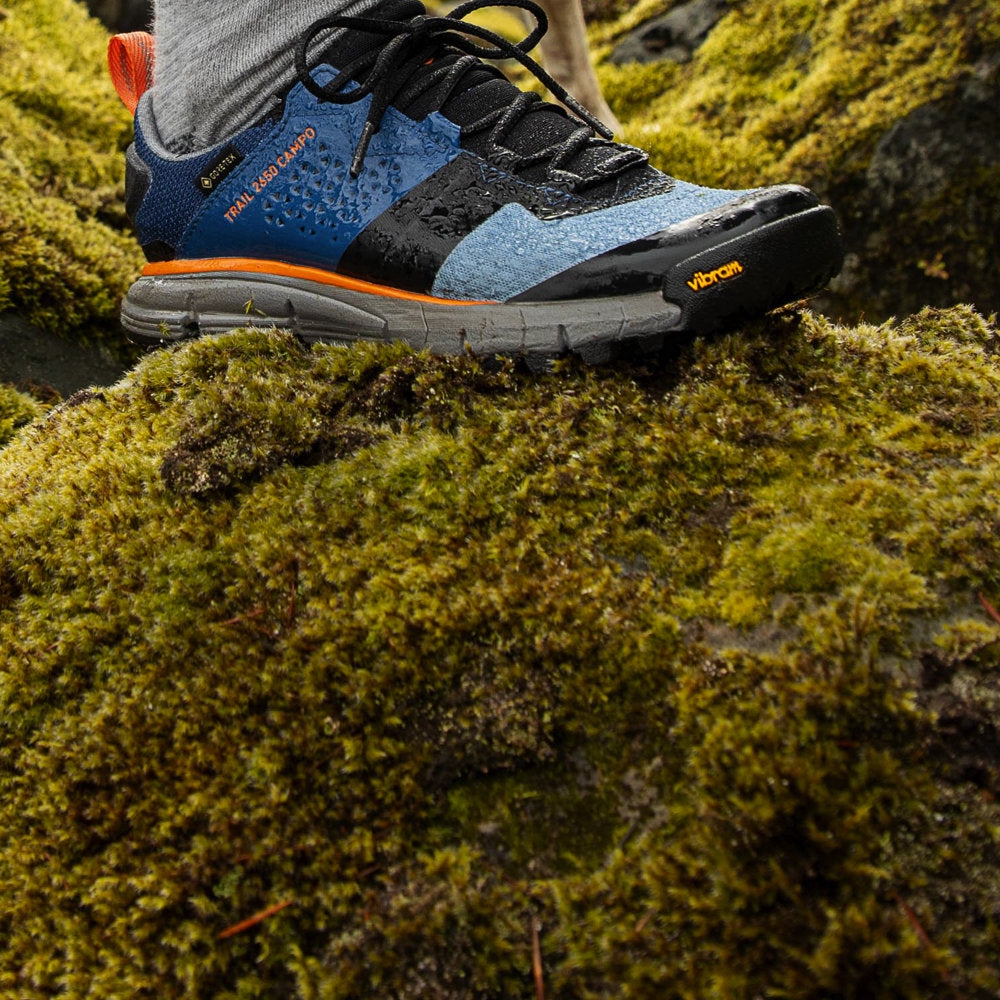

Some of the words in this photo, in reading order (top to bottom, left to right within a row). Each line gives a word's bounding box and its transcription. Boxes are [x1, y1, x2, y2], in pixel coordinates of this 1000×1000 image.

[224, 192, 254, 223] TRAIL
[252, 165, 279, 193] 2650
[276, 127, 316, 168] CAMPO
[686, 260, 743, 291] vibram
